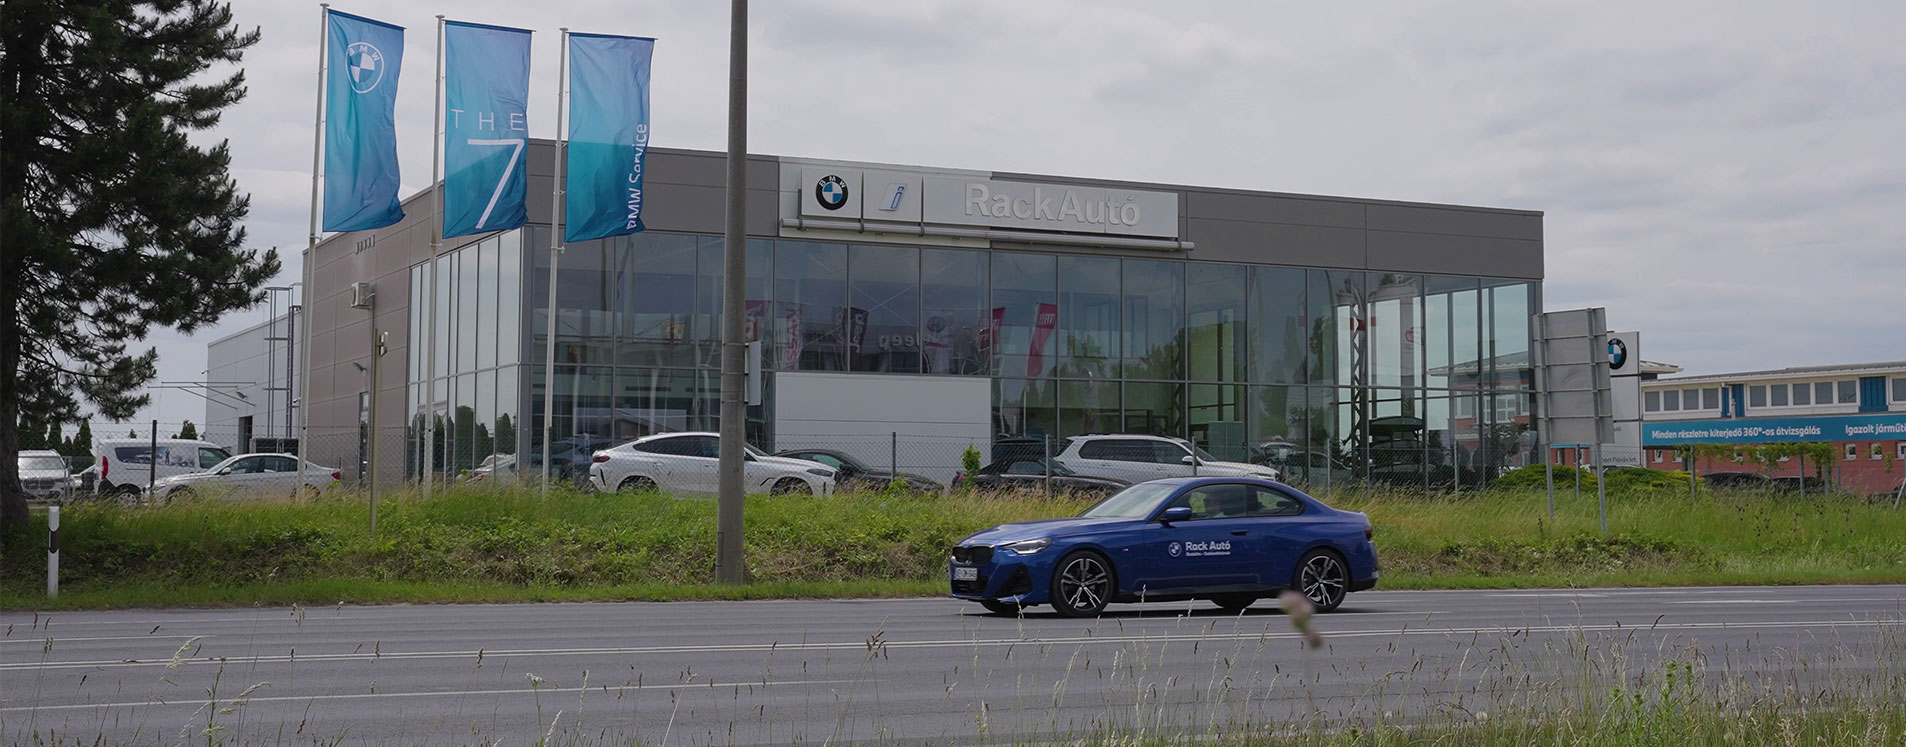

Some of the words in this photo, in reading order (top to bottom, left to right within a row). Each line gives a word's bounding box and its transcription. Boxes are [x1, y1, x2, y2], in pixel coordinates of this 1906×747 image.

[348, 45, 380, 61] BMW
[451, 109, 524, 131] THE
[628, 123, 647, 184] Service
[467, 139, 524, 229] 7
[819, 175, 846, 188] BMW
[965, 183, 1055, 221] Rack
[1057, 189, 1141, 226] Autó
[1652, 430, 1677, 439] Minden
[1678, 429, 1709, 438] részletre
[1710, 428, 1742, 438] kiterjedő
[1776, 425, 1821, 437] átvizsgálás
[1845, 424, 1874, 436] Igazolt
[1185, 541, 1208, 551] Rack
[1209, 540, 1230, 550] Autó
